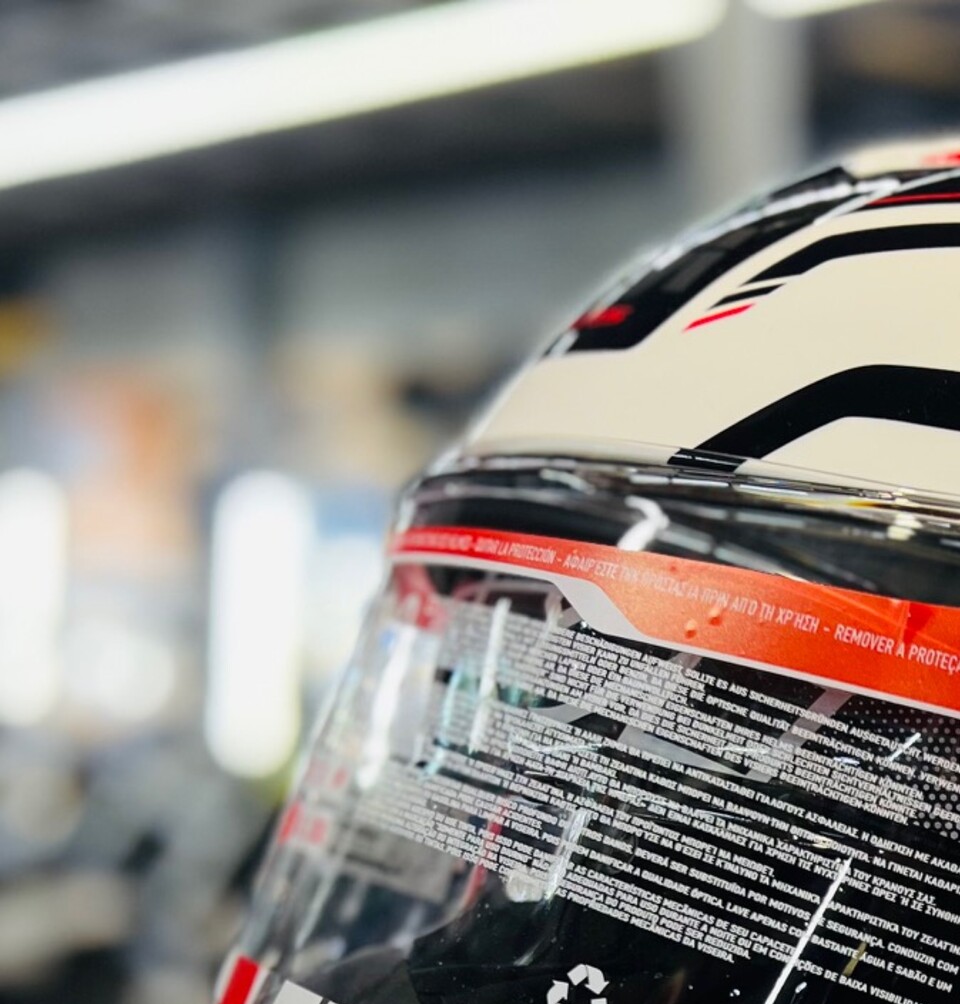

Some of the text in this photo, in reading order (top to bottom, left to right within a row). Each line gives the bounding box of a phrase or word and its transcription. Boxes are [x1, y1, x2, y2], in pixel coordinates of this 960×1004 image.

[834, 623, 895, 657] REMOVER
[896, 642, 905, 658] A
[728, 683, 748, 697] AUS
[705, 695, 748, 716] OPTISCHE
[747, 889, 767, 904] POR
[767, 897, 811, 920] MOTIVOS
[825, 918, 887, 948] SEGURANÇA.
[886, 941, 935, 966] CONDUZIR
[935, 959, 960, 975] COM
[838, 974, 868, 992] BAIXA
[894, 964, 928, 983] SABÃO
